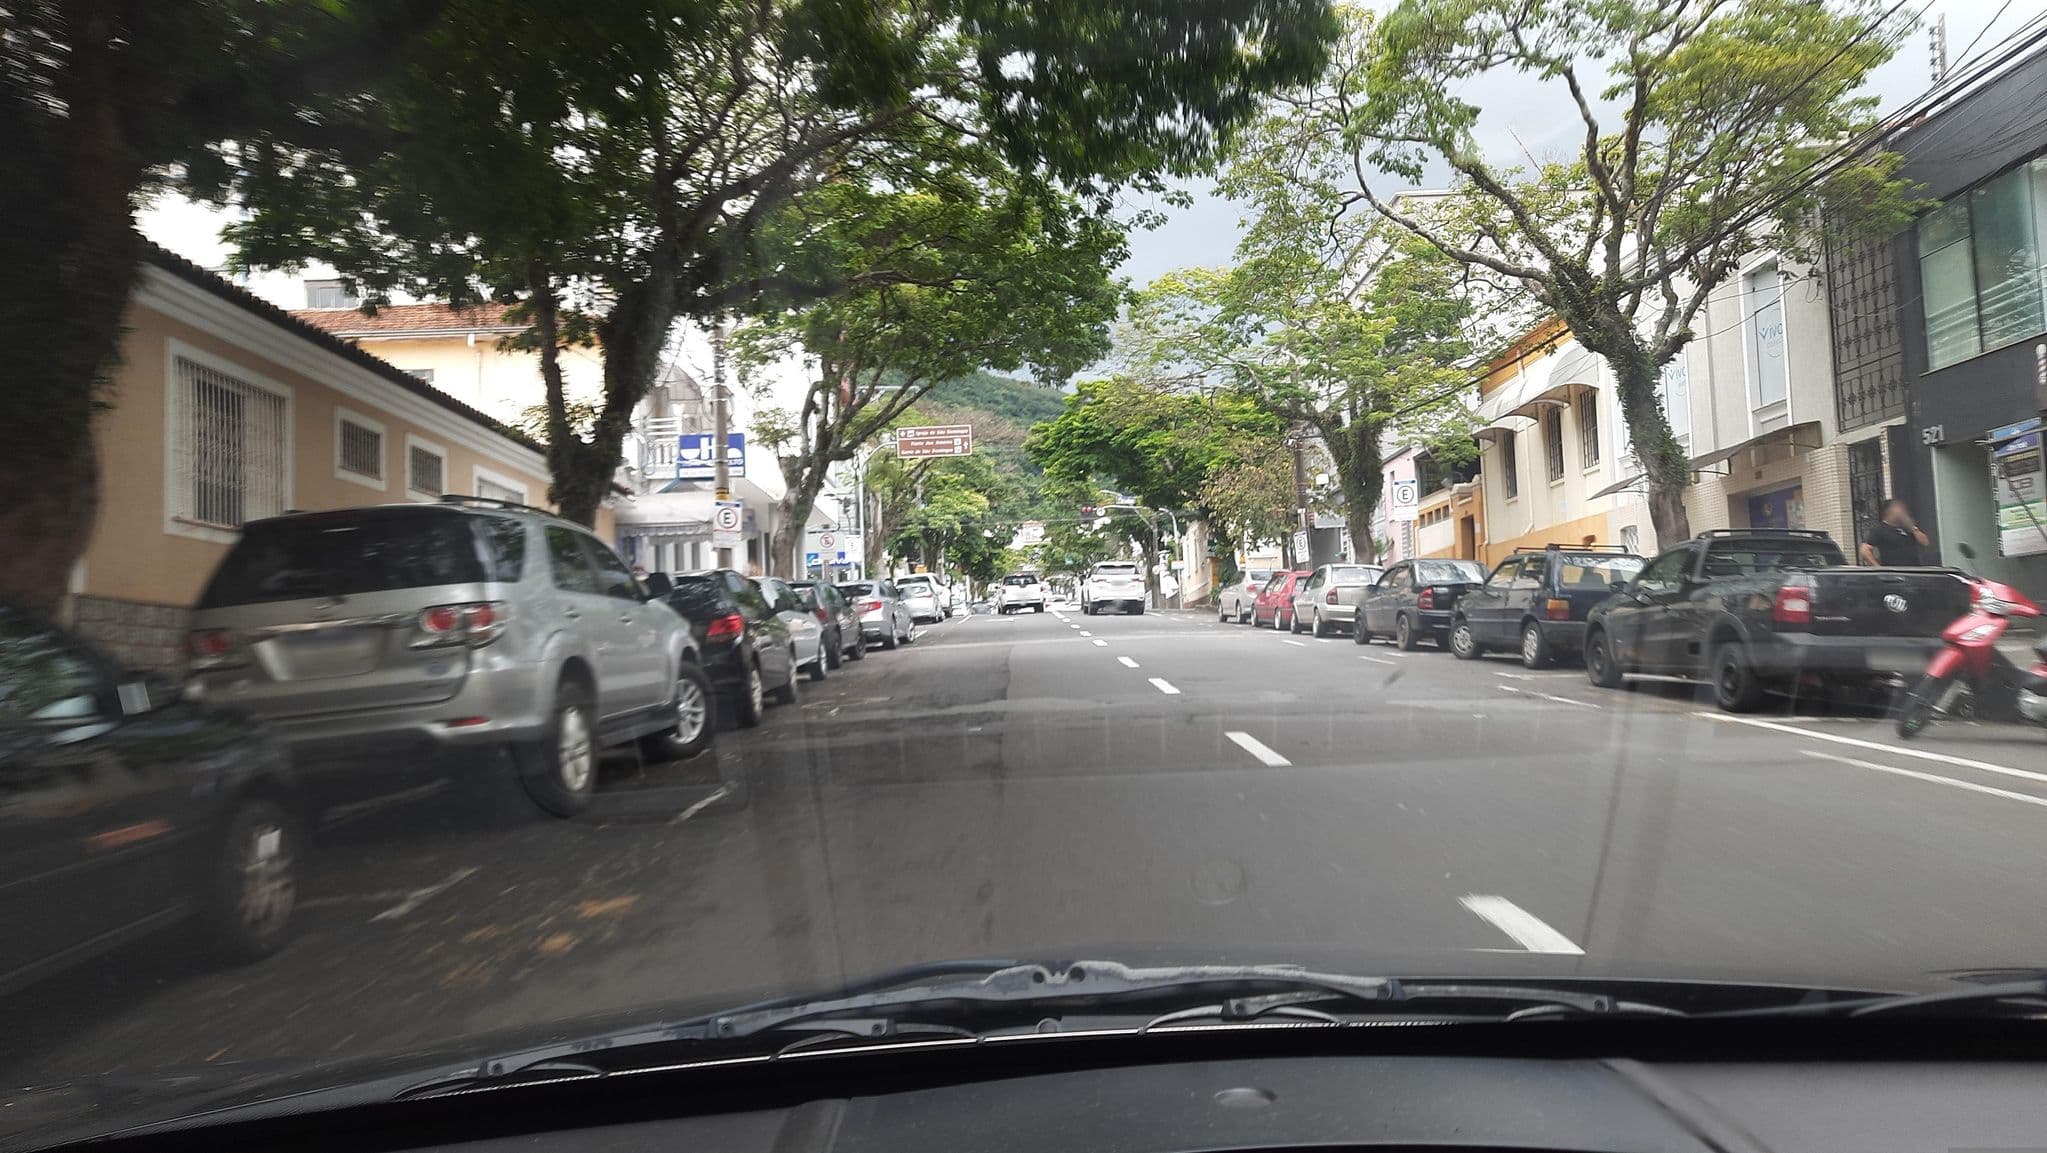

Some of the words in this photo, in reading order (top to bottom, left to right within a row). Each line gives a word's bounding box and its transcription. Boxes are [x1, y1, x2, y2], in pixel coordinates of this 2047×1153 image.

[1922, 424, 1944, 445] 521
[1402, 489, 1409, 500] E
[723, 512, 732, 524] E
[1298, 538, 1304, 547] E
